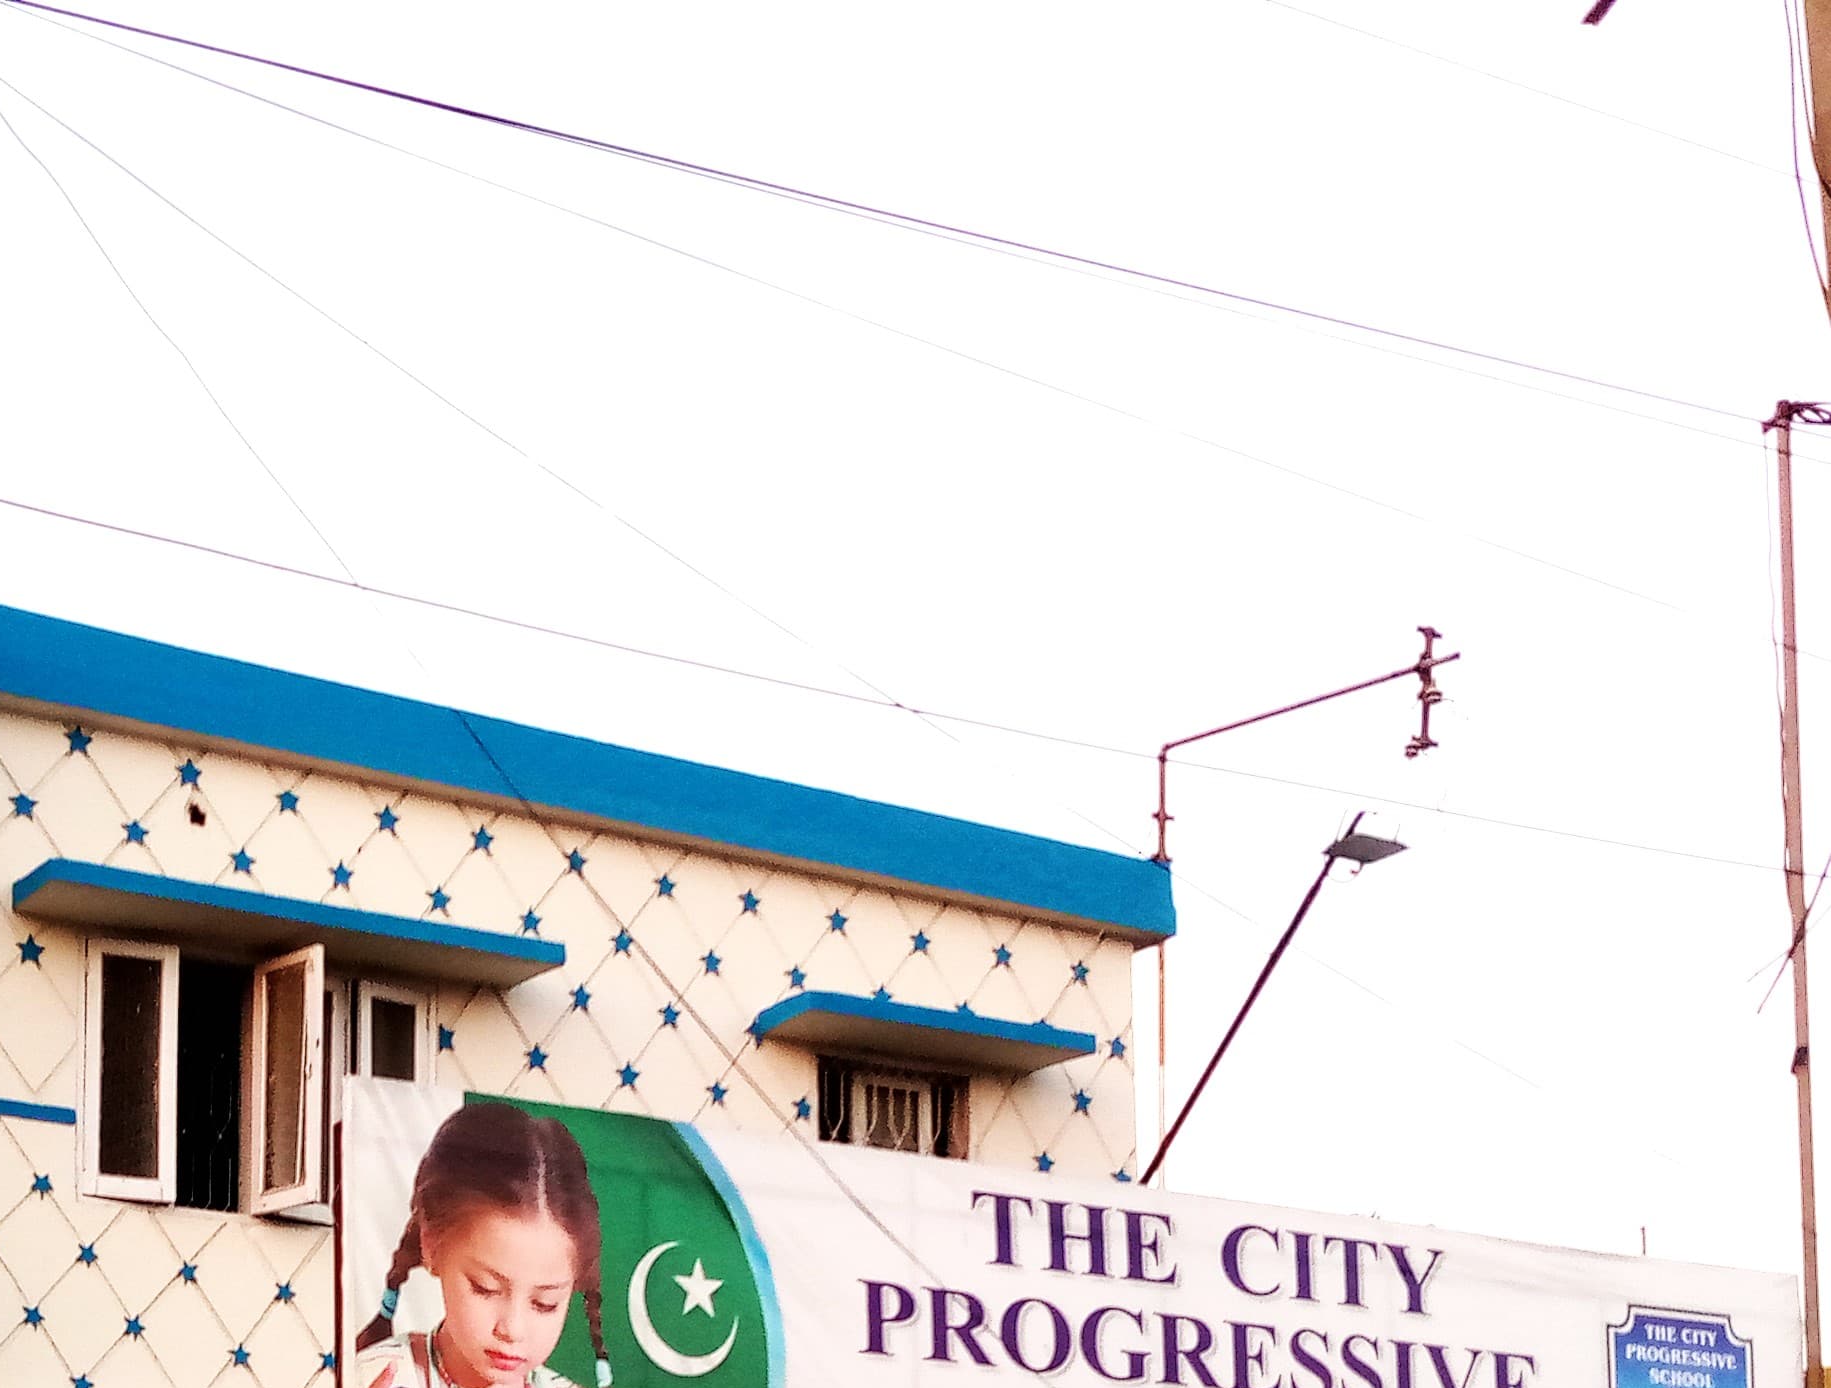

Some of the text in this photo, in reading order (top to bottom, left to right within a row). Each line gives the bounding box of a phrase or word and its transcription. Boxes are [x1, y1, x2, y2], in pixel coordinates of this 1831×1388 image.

[971, 1190, 1444, 1315] THE CITY
[1644, 1323, 1717, 1347] THE CITY
[1625, 1343, 1737, 1370] PROGRESSIVE
